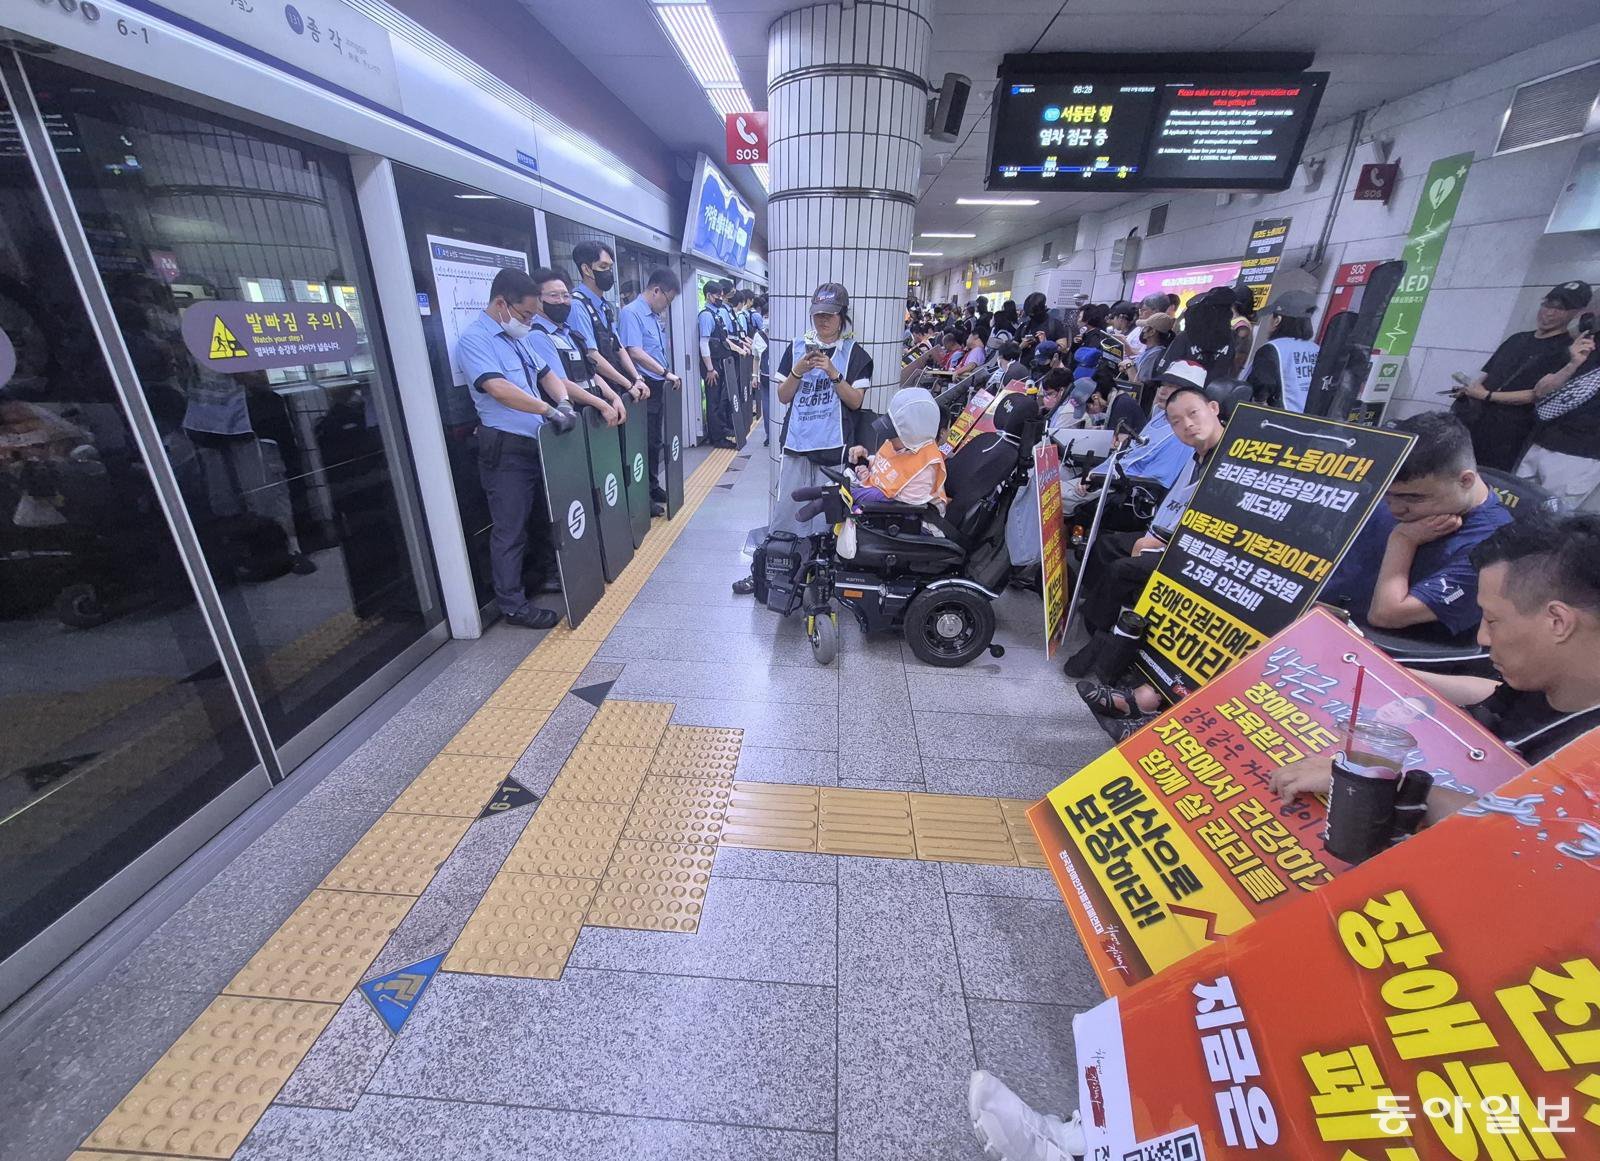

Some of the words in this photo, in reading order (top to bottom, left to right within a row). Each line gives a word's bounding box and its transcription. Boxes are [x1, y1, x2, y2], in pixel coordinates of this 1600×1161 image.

[117, 18, 150, 44] 6-1
[1040, 128, 1064, 146] 열차
[1067, 128, 1092, 146] 접근
[1094, 128, 1108, 146] 중
[1061, 105, 1096, 122] 서동탄
[1100, 104, 1114, 122] 행
[736, 149, 759, 160] SOS
[1350, 264, 1366, 274] SOS
[1398, 274, 1428, 292] AED
[245, 312, 298, 334] 발빠짐
[306, 312, 343, 331] 주의!
[252, 335, 274, 344] Watch
[274, 336, 288, 344] your
[254, 347, 276, 357] 열차와
[278, 345, 298, 356] 승강장
[298, 344, 317, 353] 사이가
[1228, 437, 1281, 464] 이것도
[1282, 449, 1374, 483] 노동이다!
[1213, 462, 1360, 514] 권리중심공공일자리
[1236, 490, 1292, 522] 제도화!
[1176, 534, 1252, 578] 특별교통수단
[1250, 567, 1304, 606] 운전원
[1181, 508, 1238, 544] 이동권은
[1233, 528, 1334, 583] 기본권이다!
[1181, 560, 1220, 586] 2.5명
[1218, 576, 1265, 614] 인건비!
[1182, 707, 1217, 734] 감옥
[1206, 730, 1245, 760] 같은
[1215, 696, 1306, 768] 교육받고
[1244, 681, 1340, 752] 장애인도
[1138, 748, 1189, 798] 함께
[1152, 717, 1246, 803] 지역에서
[489, 786, 520, 810] 6-1
[1174, 790, 1216, 828] 살
[1064, 793, 1167, 929] 보장하라!
[1099, 775, 1204, 901] 예산으로
[1194, 814, 1288, 903] 권리를
[1190, 975, 1280, 1150] 지금은
[1494, 957, 1600, 1127] 진
[1301, 1044, 1423, 1161] 폐
